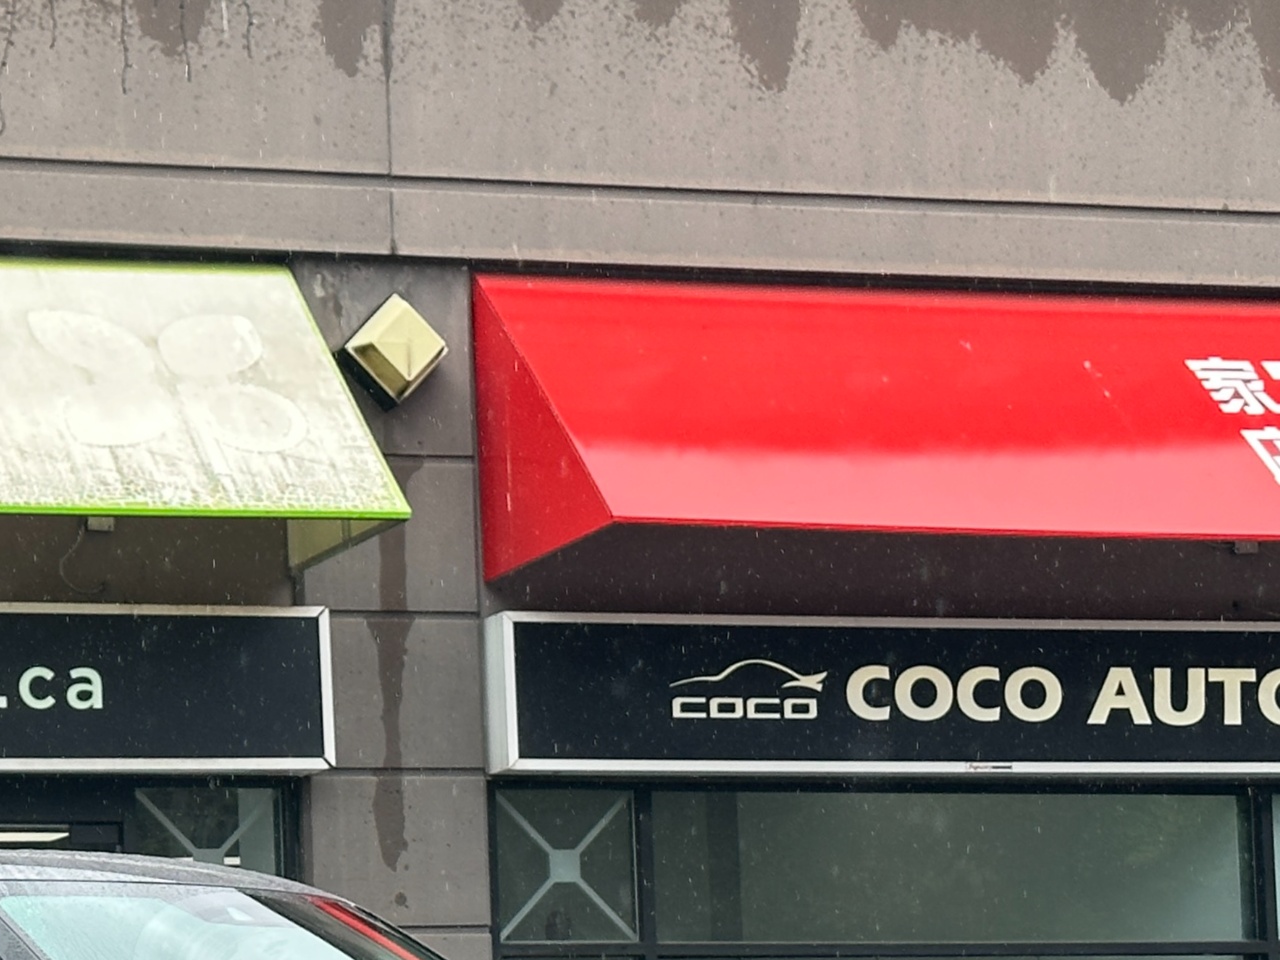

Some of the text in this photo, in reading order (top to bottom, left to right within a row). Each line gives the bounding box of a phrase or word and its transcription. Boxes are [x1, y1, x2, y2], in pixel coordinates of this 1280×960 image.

[1183, 356, 1280, 415] 家
[672, 697, 818, 719] COCO
[846, 664, 1062, 722] COCO
